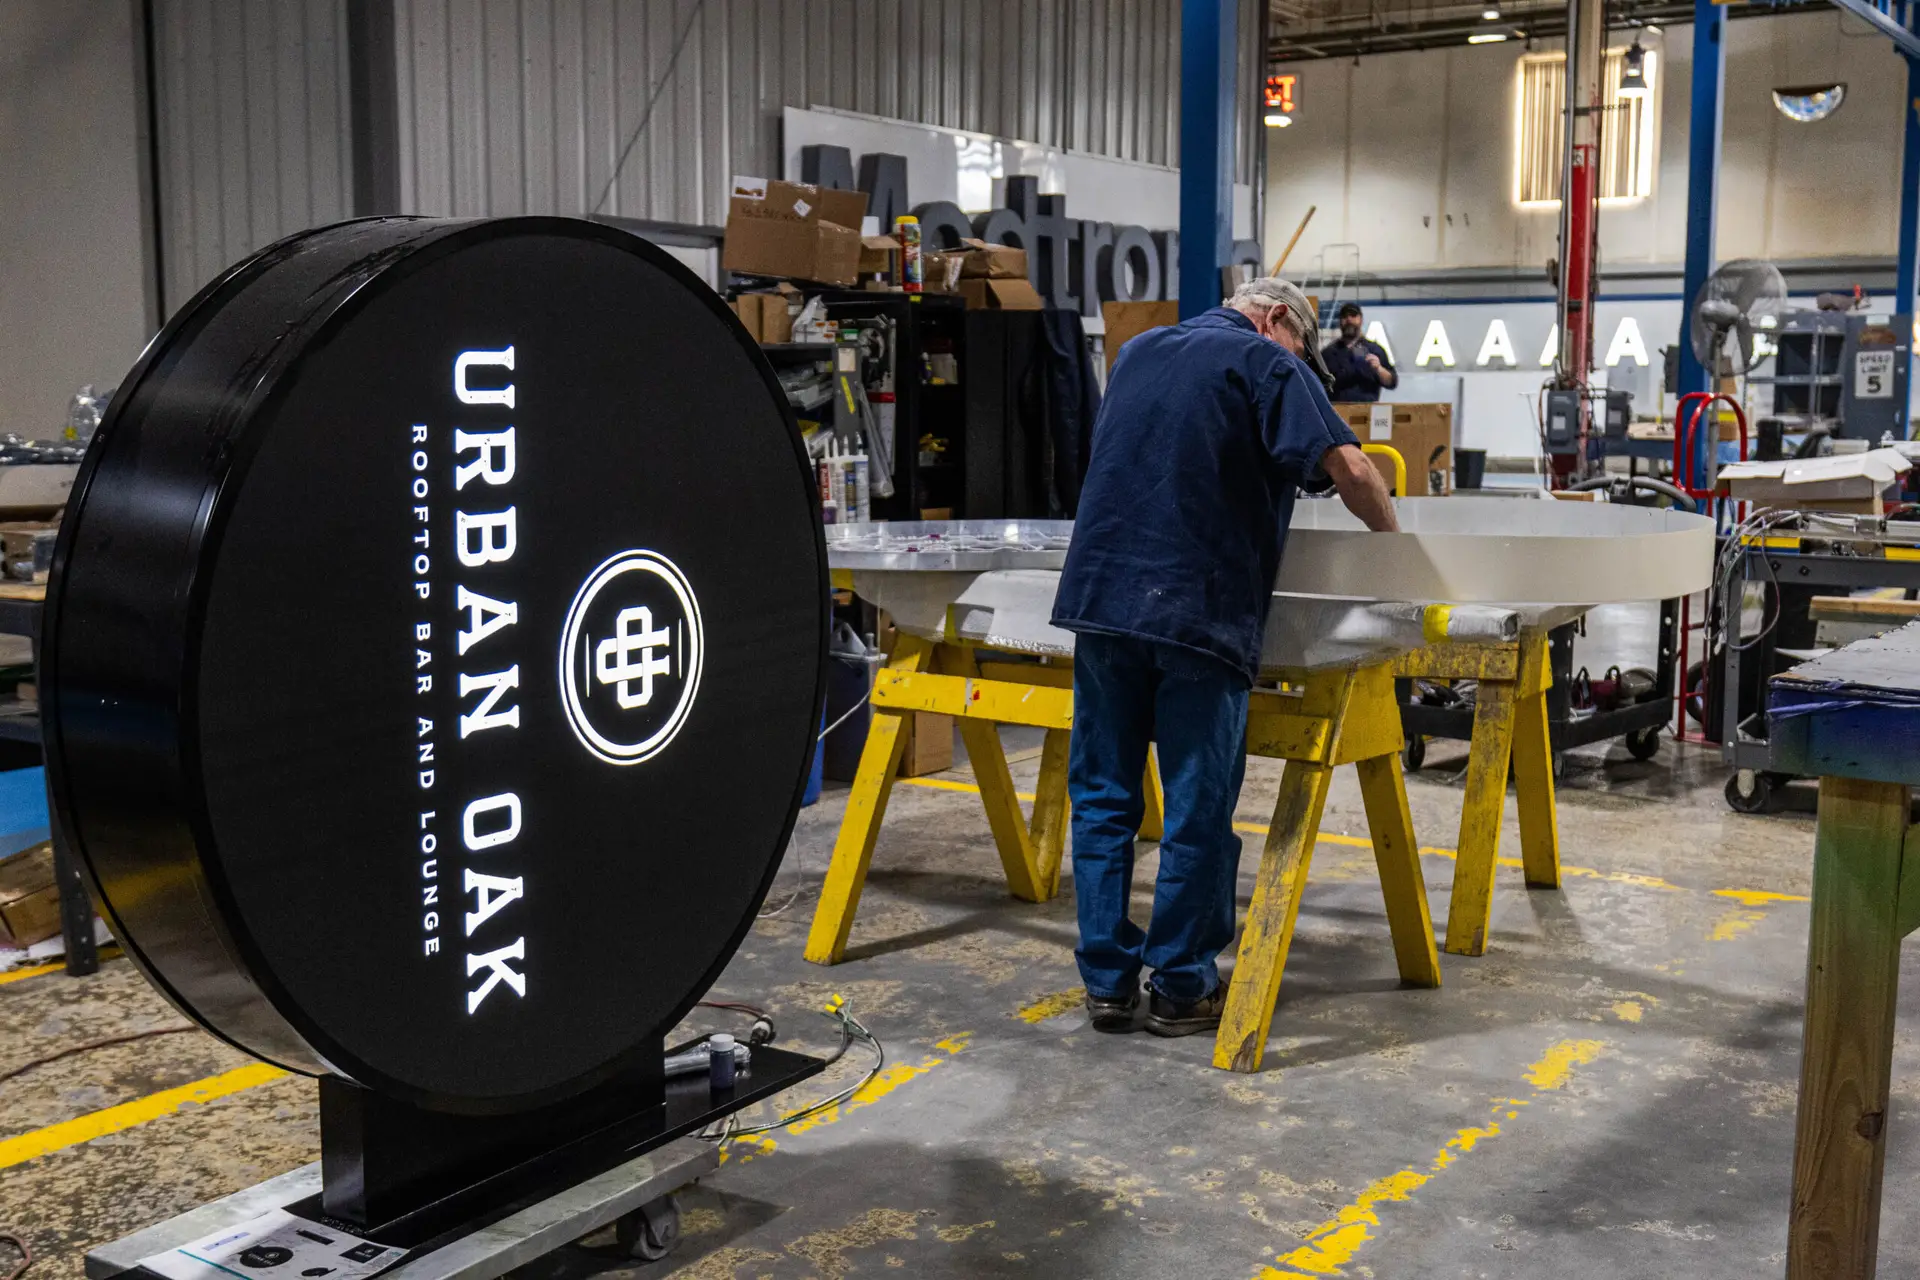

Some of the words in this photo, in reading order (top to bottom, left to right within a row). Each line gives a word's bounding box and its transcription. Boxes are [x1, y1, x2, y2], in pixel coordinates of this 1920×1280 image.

[1415, 319, 1456, 367] A
[1475, 318, 1517, 367] A
[1604, 316, 1650, 367] A
[1867, 375, 1882, 393] 5
[412, 424, 431, 599] ROOFTOP
[454, 345, 520, 740] URBAN
[416, 622, 433, 695] BAR
[418, 717, 435, 789] AND
[421, 810, 440, 956] LOUNGE
[462, 792, 526, 1015] OAK
